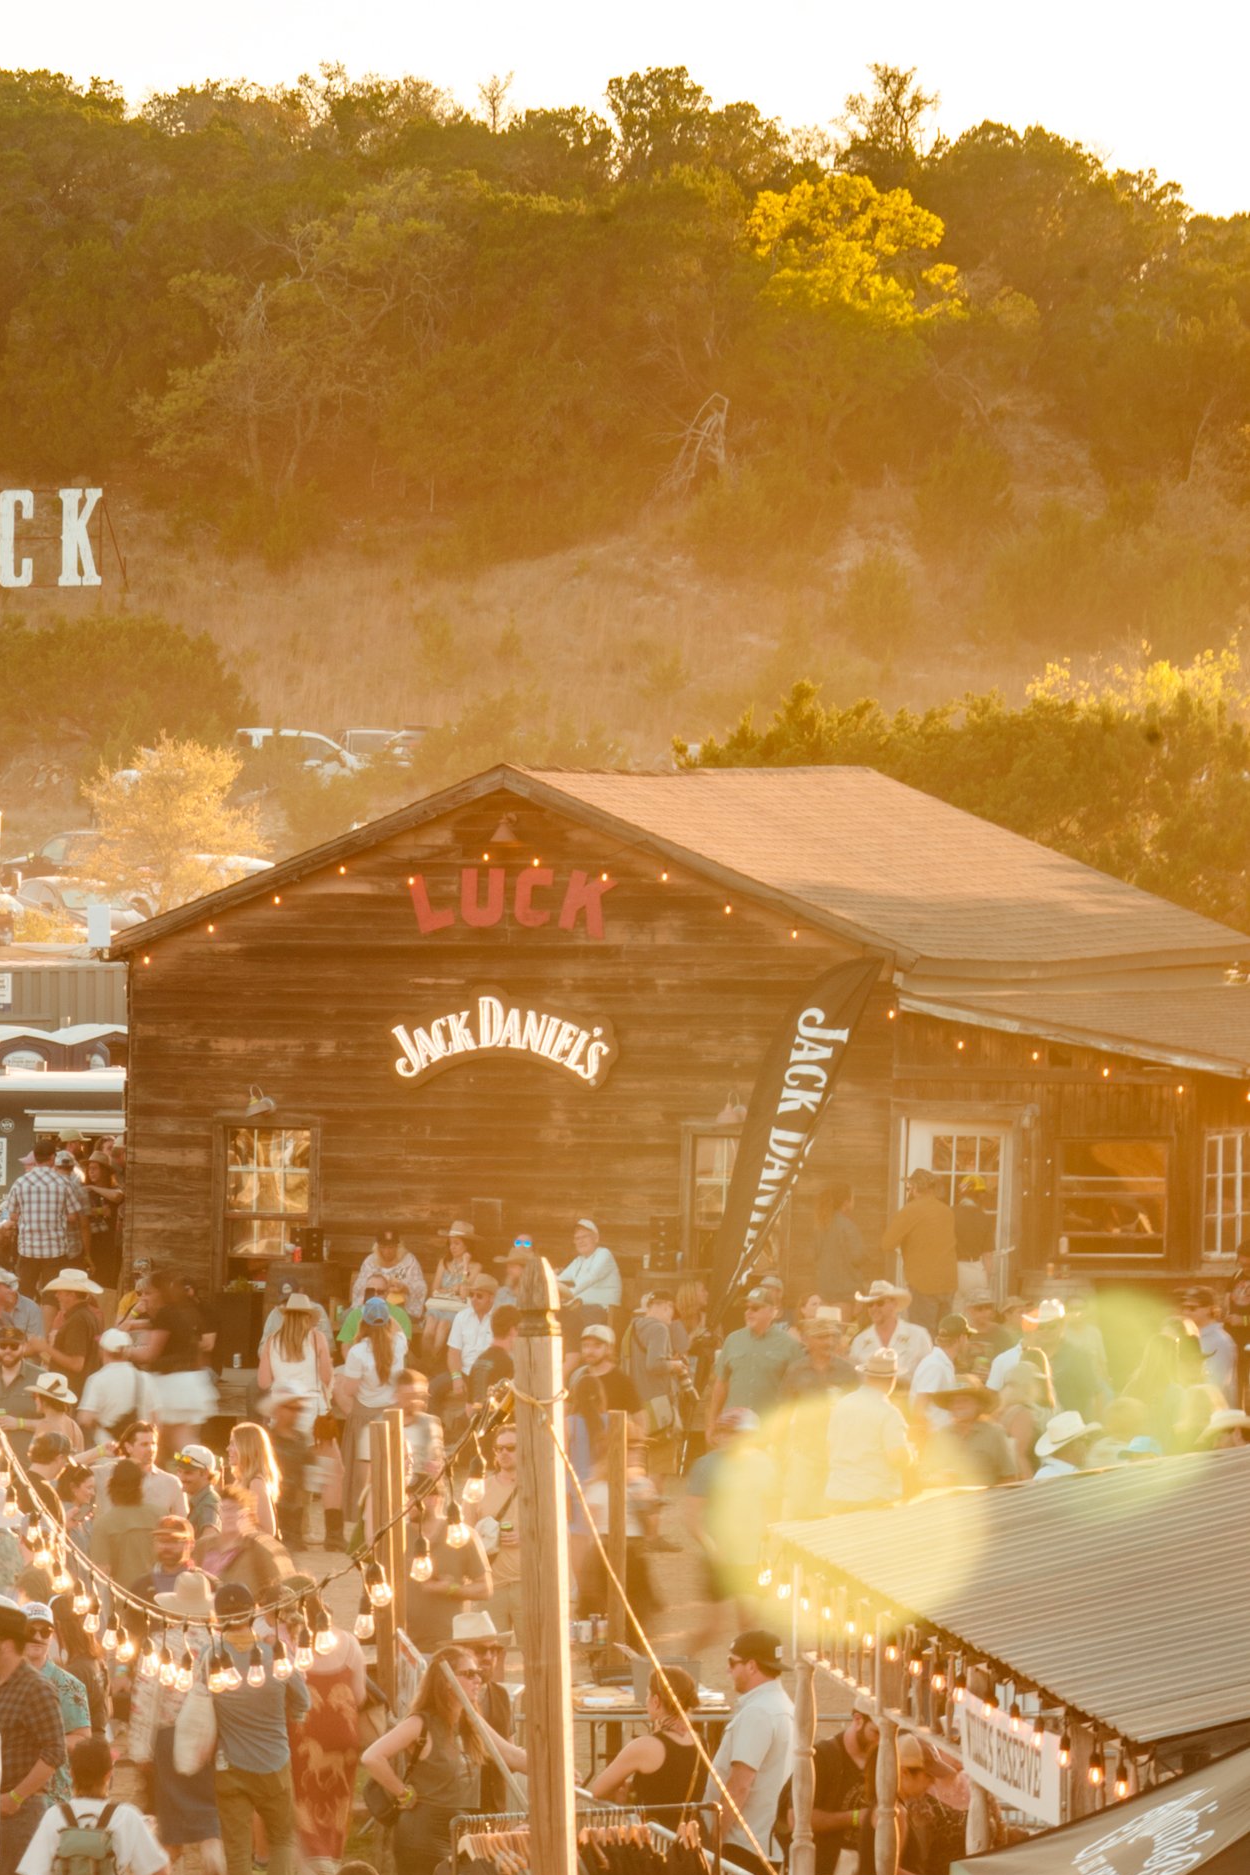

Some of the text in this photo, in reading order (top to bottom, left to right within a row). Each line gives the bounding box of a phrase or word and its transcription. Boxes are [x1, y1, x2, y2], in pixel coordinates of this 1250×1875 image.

[409, 867, 618, 940] LUCK
[391, 996, 610, 1080] JACK DANIEL'S
[777, 1006, 849, 1116] JACK
[996, 1727, 1042, 1800] RESERVE
